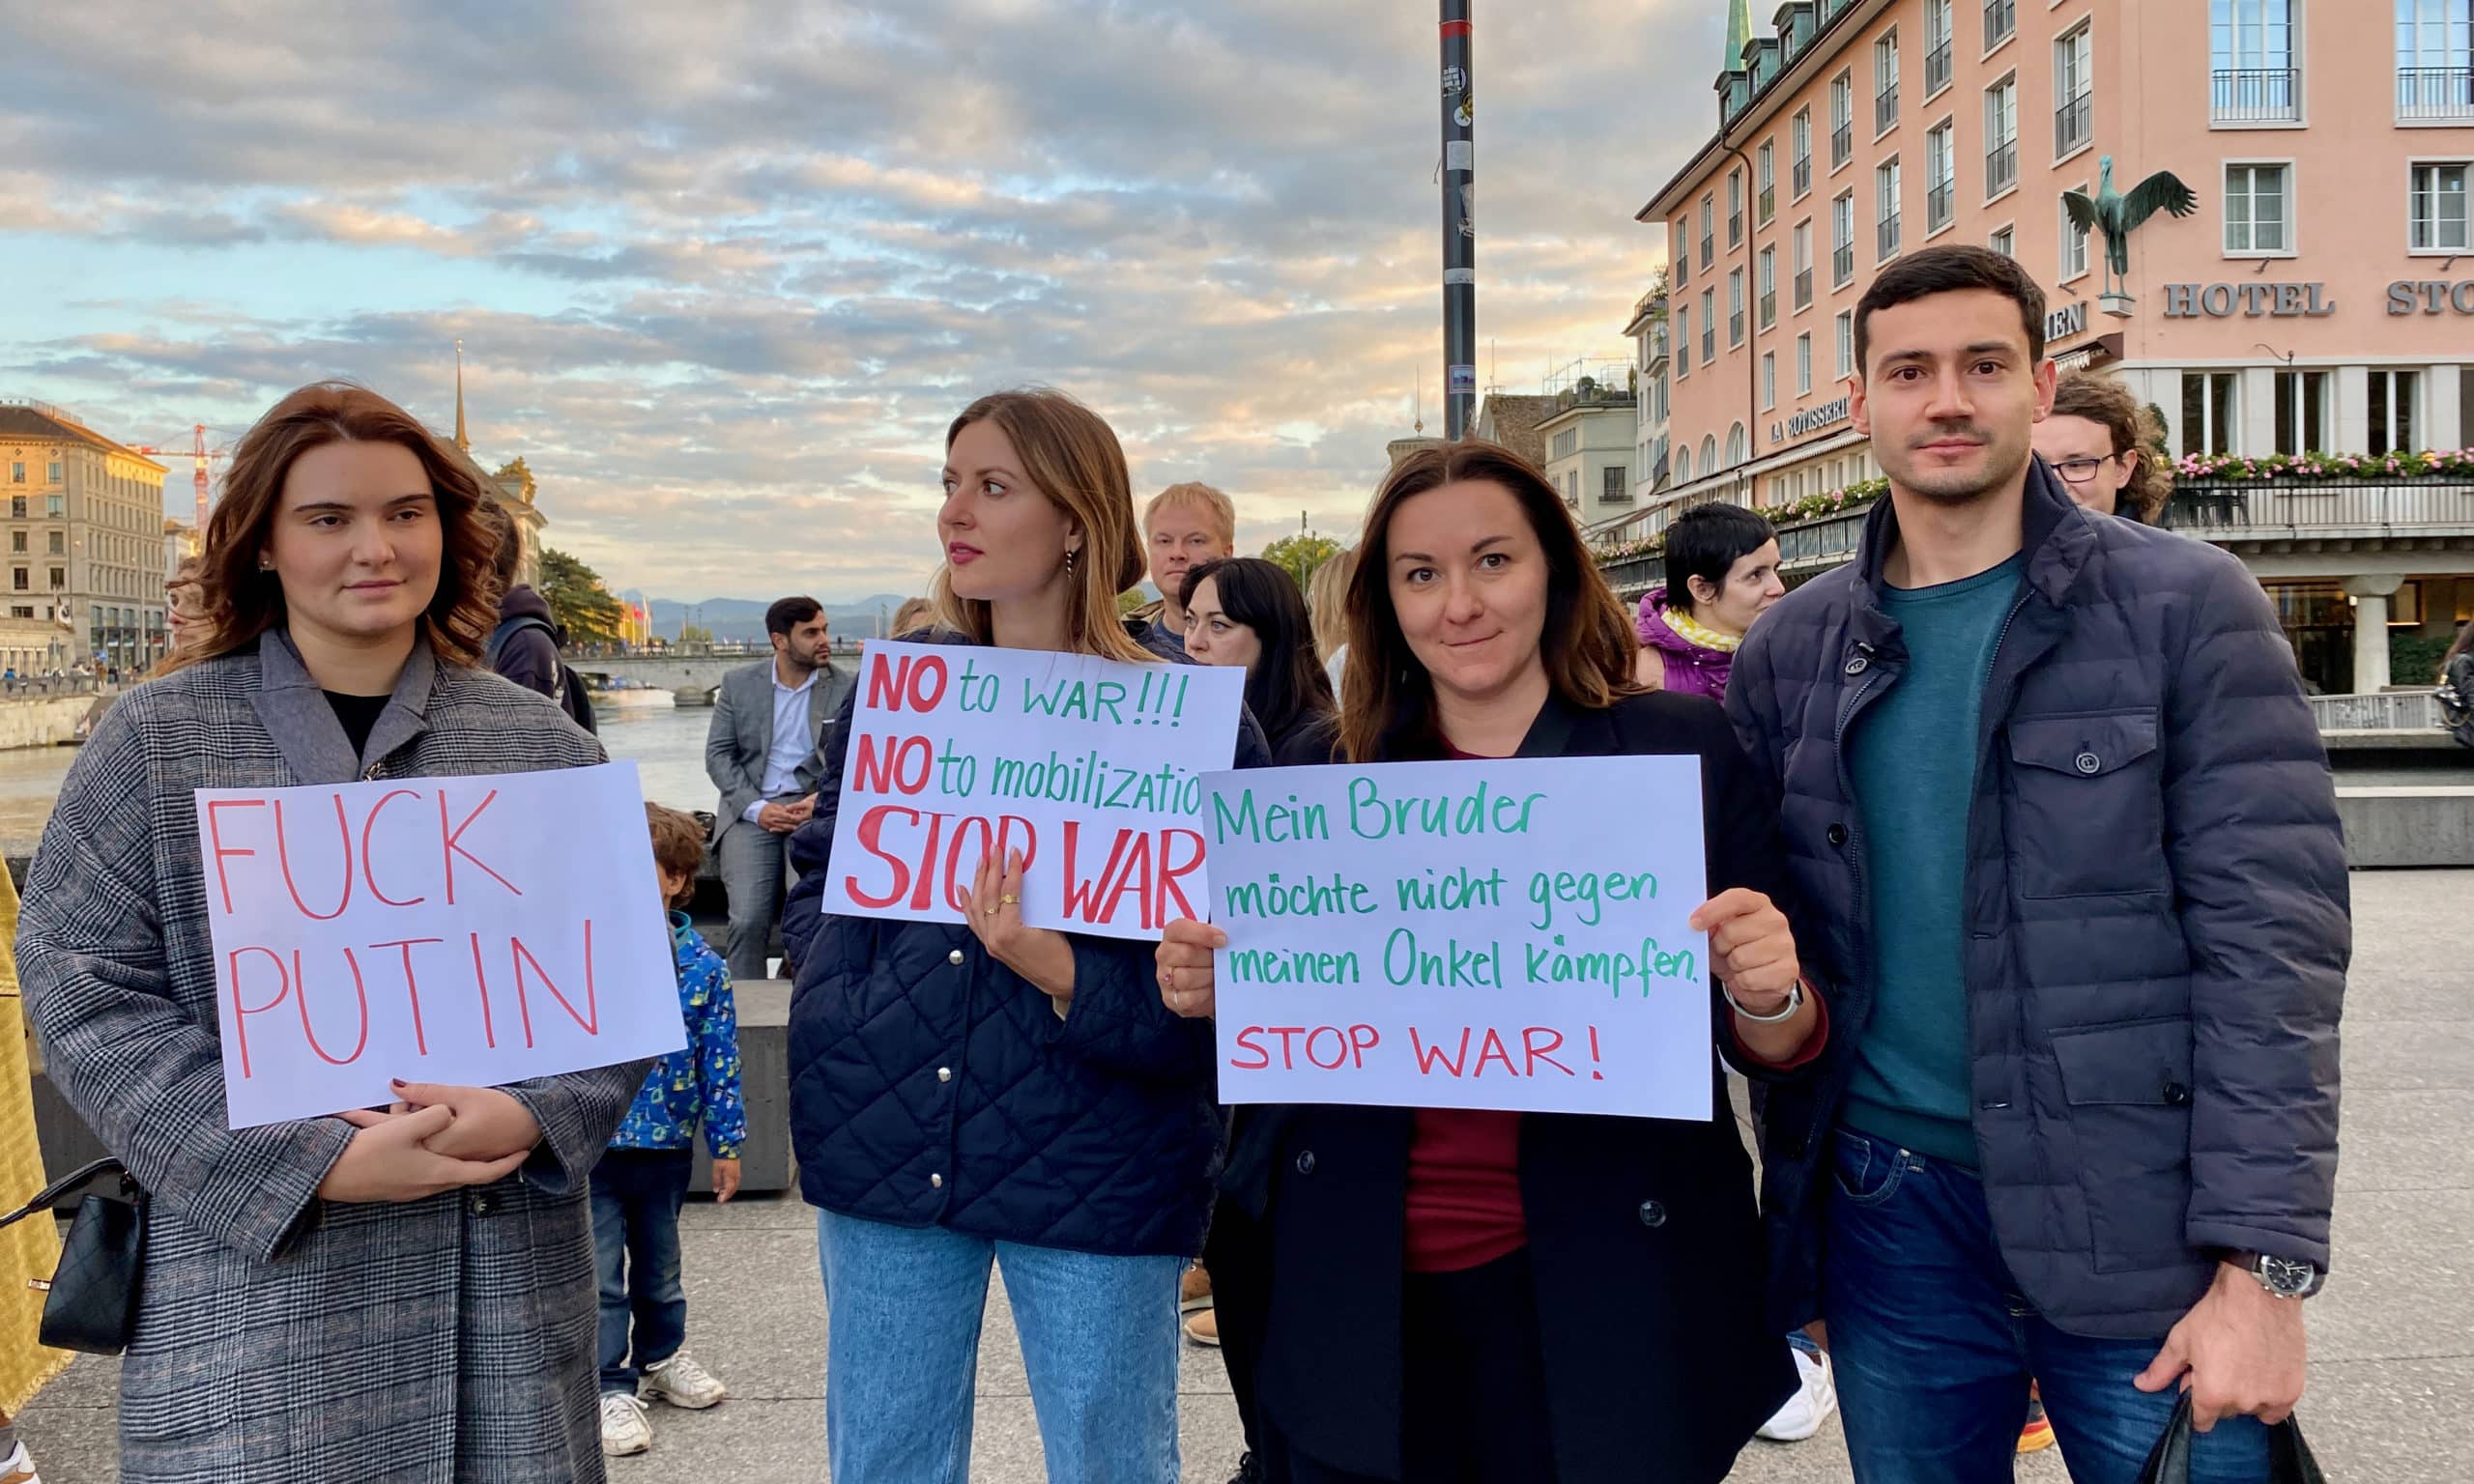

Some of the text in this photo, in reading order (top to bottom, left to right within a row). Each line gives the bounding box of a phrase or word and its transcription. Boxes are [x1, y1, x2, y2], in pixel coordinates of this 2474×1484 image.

[2164, 279, 2474, 318] HOTEL STO
[1787, 395, 1851, 438] RÔTISSERI
[866, 653, 1190, 728] NO to WAR!!!
[852, 733, 1201, 816] NO to mobilizatio
[1212, 776, 1547, 844] Mein Bruder
[208, 788, 523, 921] FUCK
[845, 805, 1207, 930] STOP WAR
[1225, 866, 1657, 930] möchte nicht gegen
[1228, 948, 1360, 985] meinen
[1383, 927, 1503, 989] Onkel
[230, 919, 598, 1079] PUTIN
[1230, 1024, 1604, 1081] STOP WAR!
